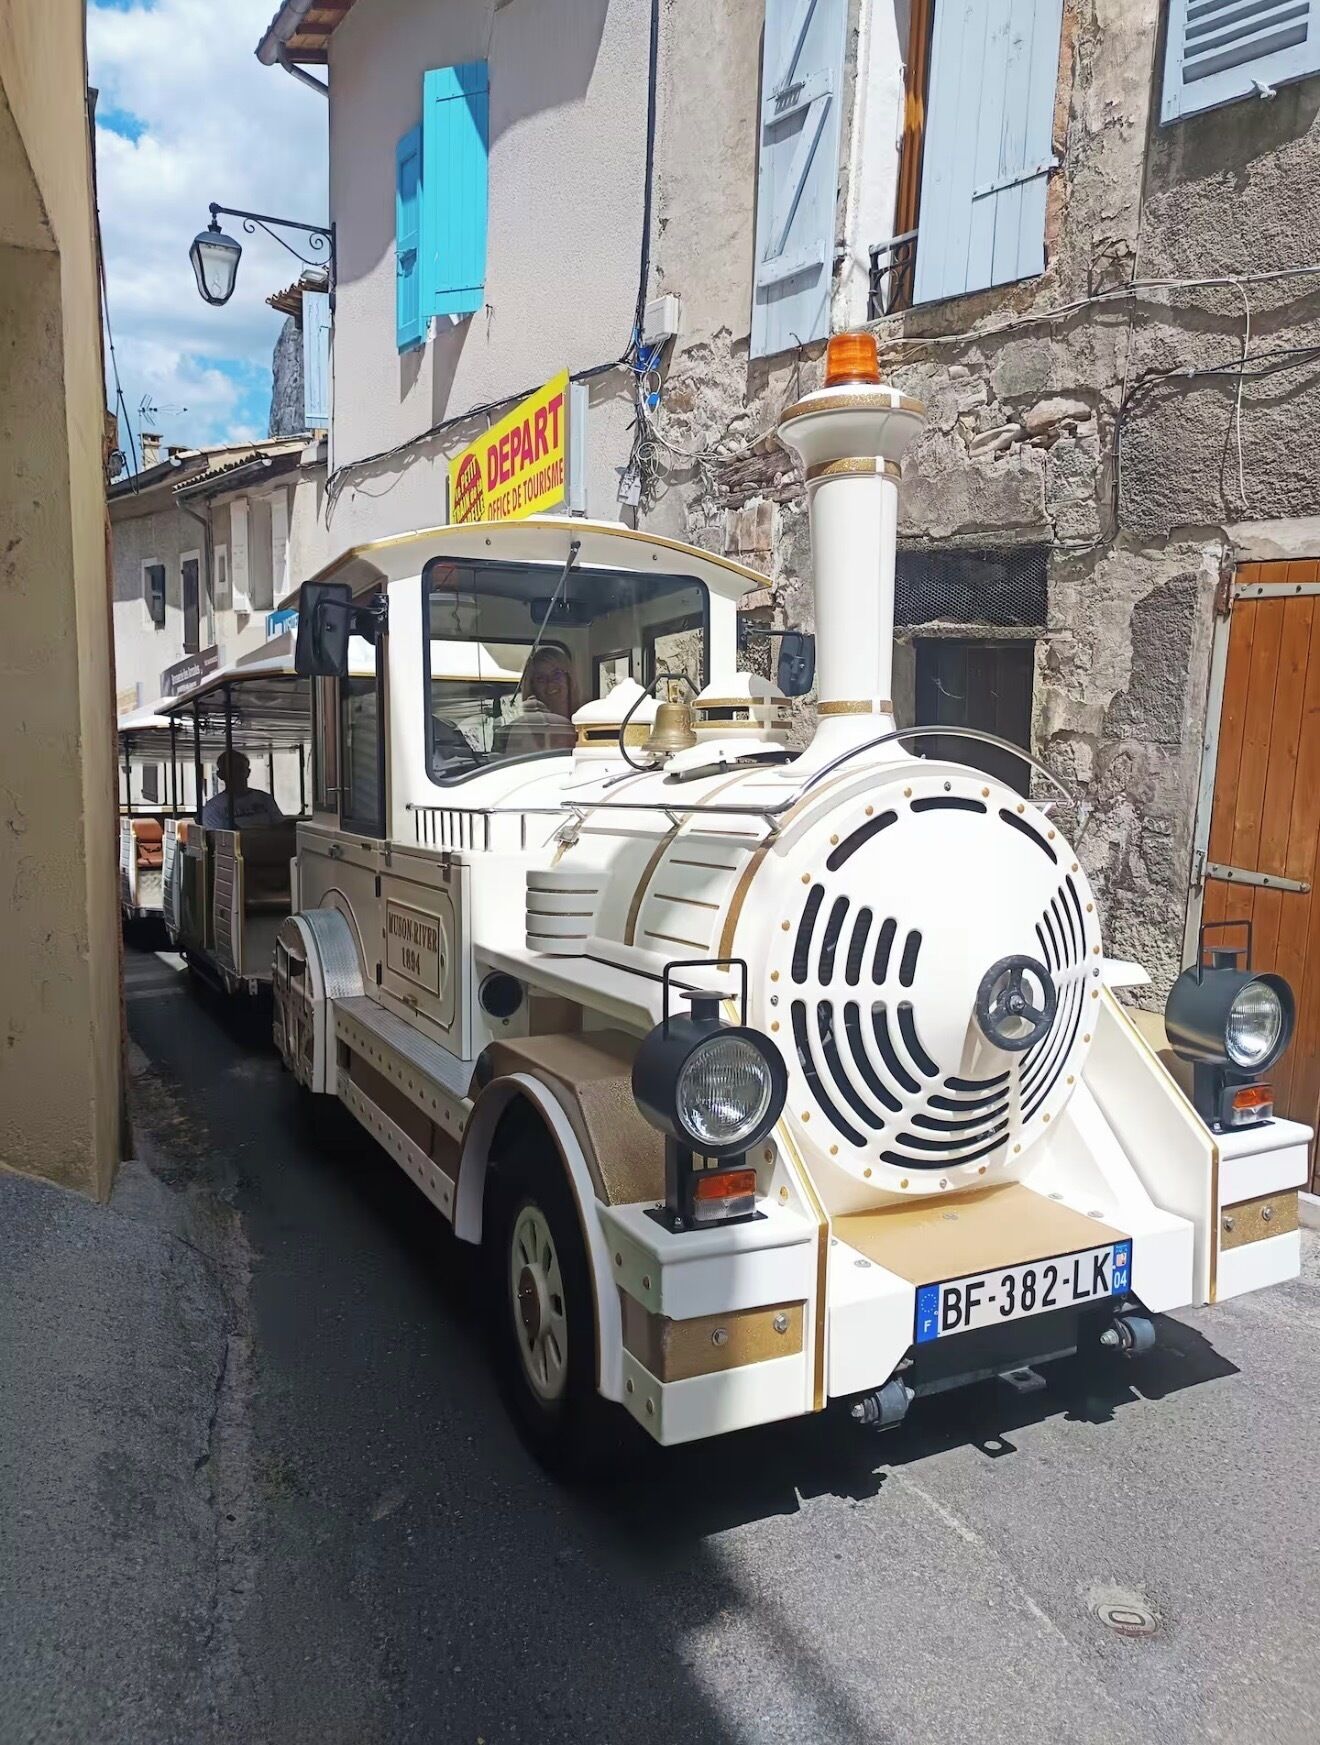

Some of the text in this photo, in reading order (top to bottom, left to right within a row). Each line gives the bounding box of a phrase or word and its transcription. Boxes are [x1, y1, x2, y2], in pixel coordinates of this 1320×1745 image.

[487, 392, 563, 493] DEPART
[487, 491, 510, 521] OFFICE
[512, 484, 521, 511] DE
[523, 457, 563, 504] TOURISME
[402, 947, 421, 976] 1894
[923, 1252, 1128, 1333] F BF-382-LK 04
